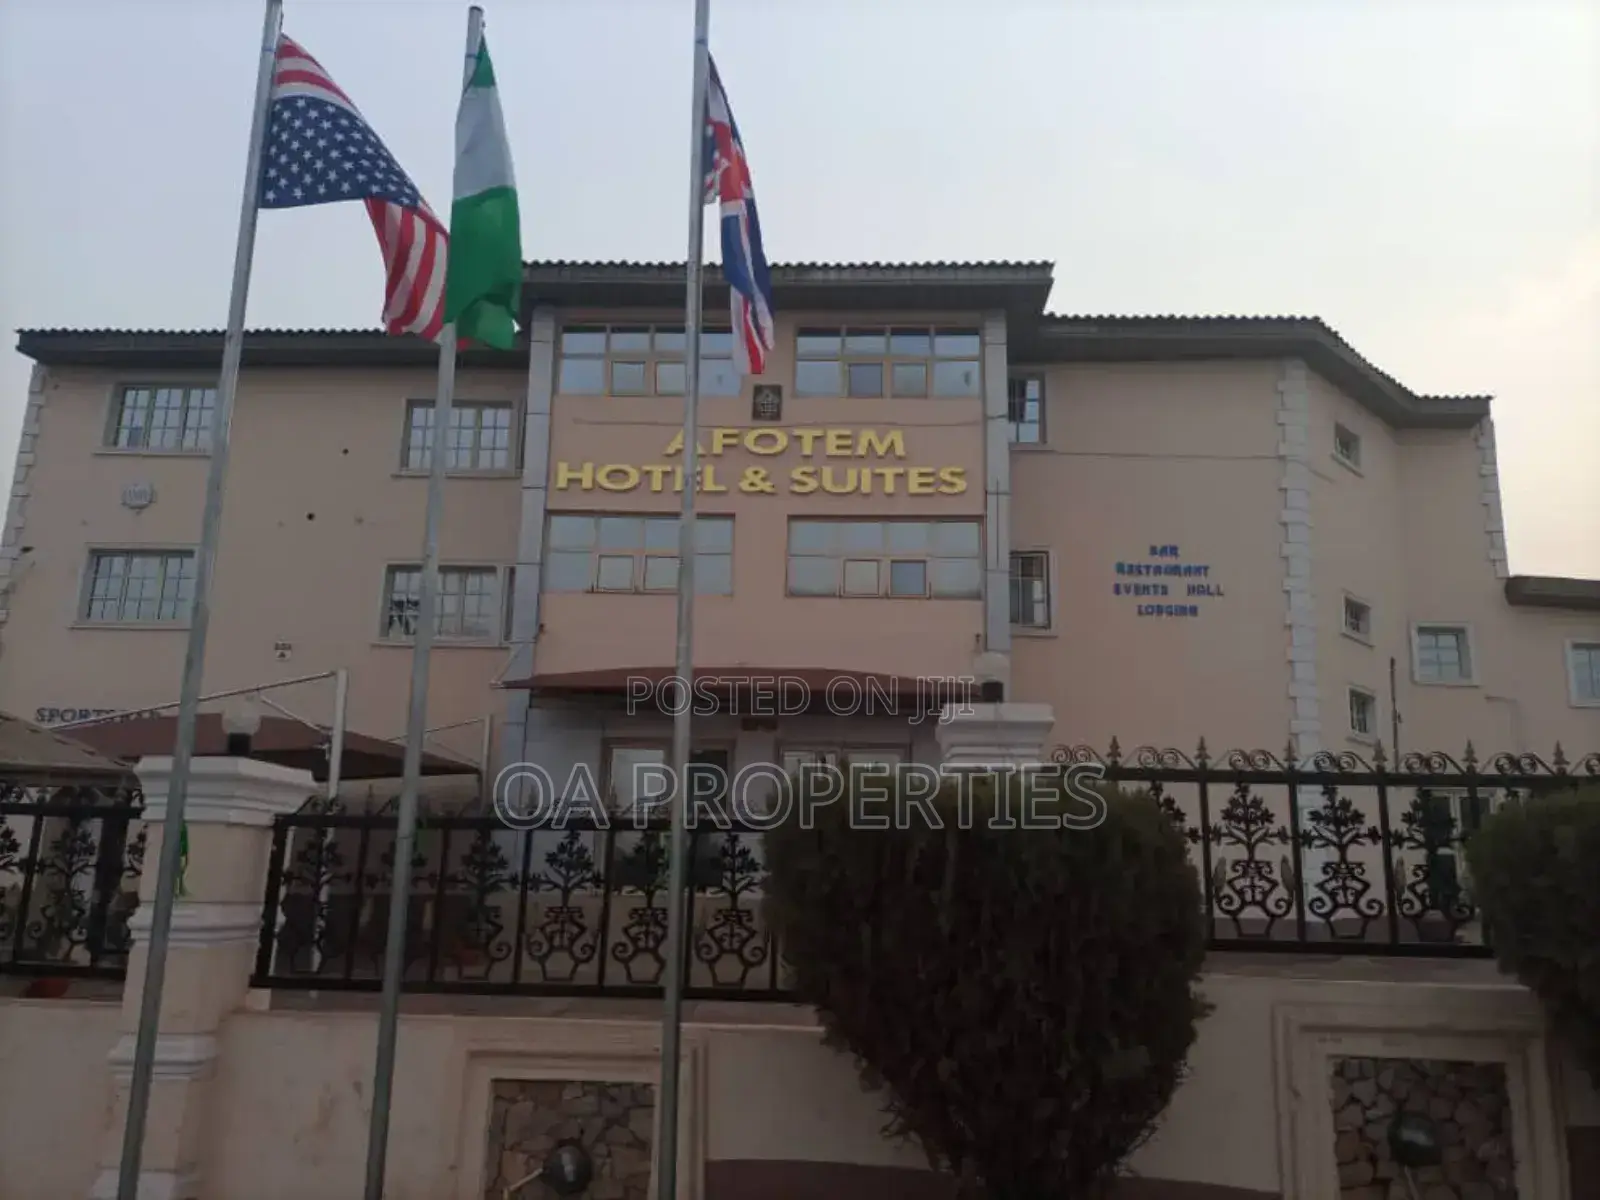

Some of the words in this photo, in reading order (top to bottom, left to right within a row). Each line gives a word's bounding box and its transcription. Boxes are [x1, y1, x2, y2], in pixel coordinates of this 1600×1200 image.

[663, 427, 906, 457] AFOTEM
[738, 466, 777, 494] &
[789, 466, 968, 495] SUITES
[1149, 544, 1180, 558] BAR
[1113, 582, 1169, 597] EVENTS
[1187, 583, 1225, 597] HALL
[35, 707, 115, 723] SPORT
